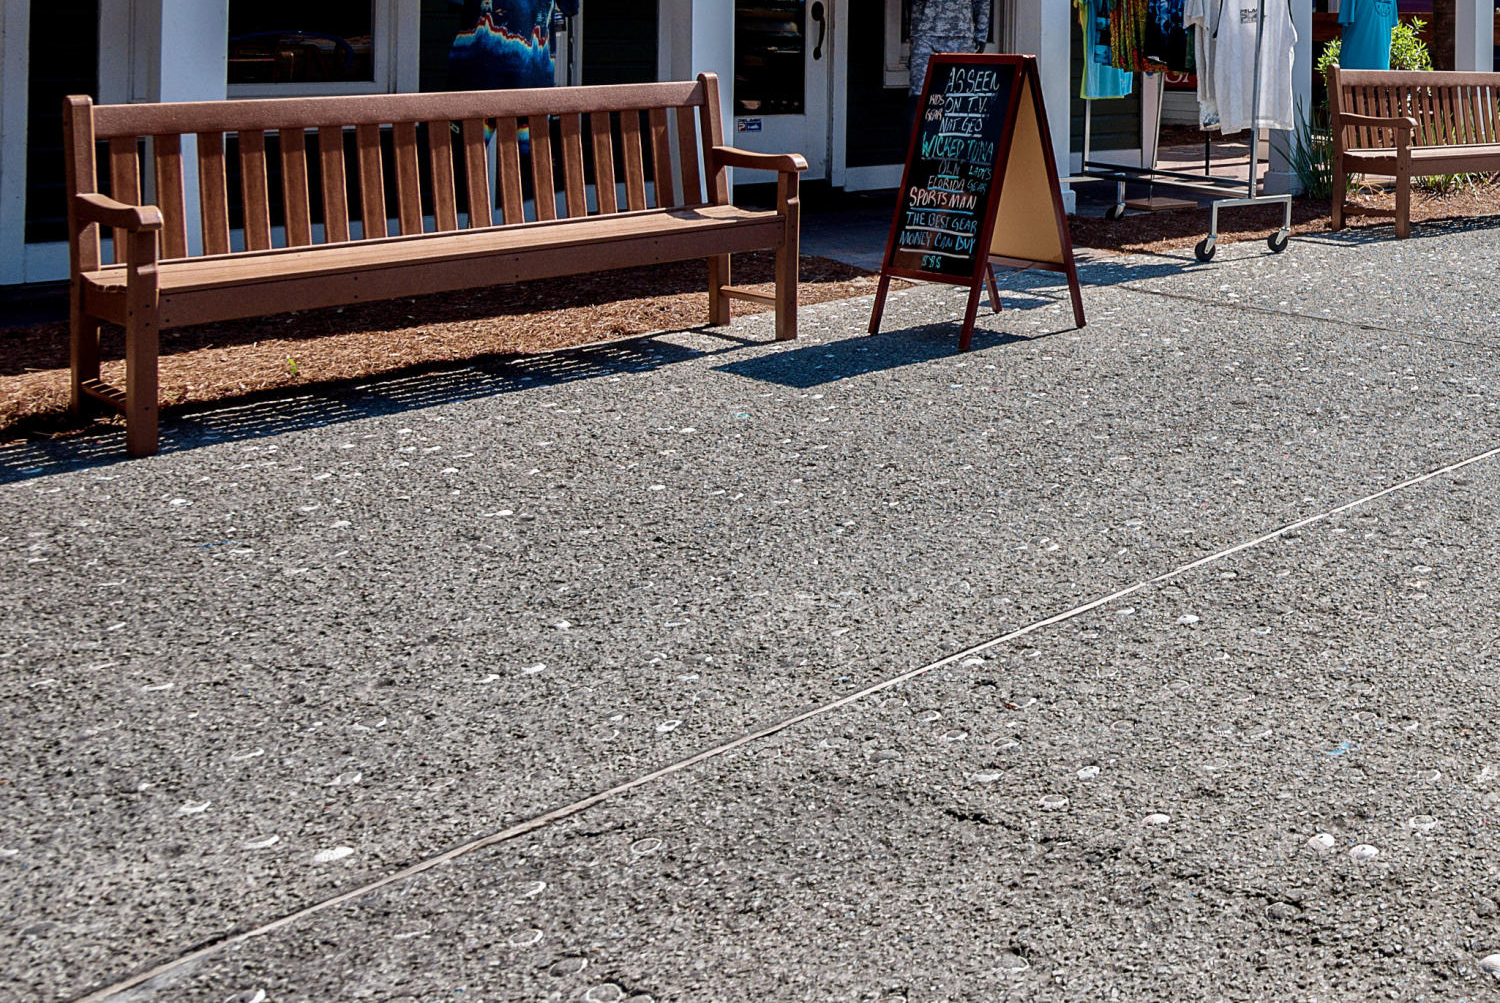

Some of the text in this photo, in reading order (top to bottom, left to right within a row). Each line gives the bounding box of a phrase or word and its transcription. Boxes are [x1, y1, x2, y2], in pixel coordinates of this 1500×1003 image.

[944, 67, 999, 93] AS SEEN
[945, 97, 961, 113] ON
[962, 117, 982, 134] GEO
[921, 131, 994, 162] WICKED TUNA
[928, 176, 965, 191] FLORIDA
[906, 211, 977, 234] THE BEST GEAR
[899, 231, 932, 247] MONEY
[955, 236, 976, 254] BUY
